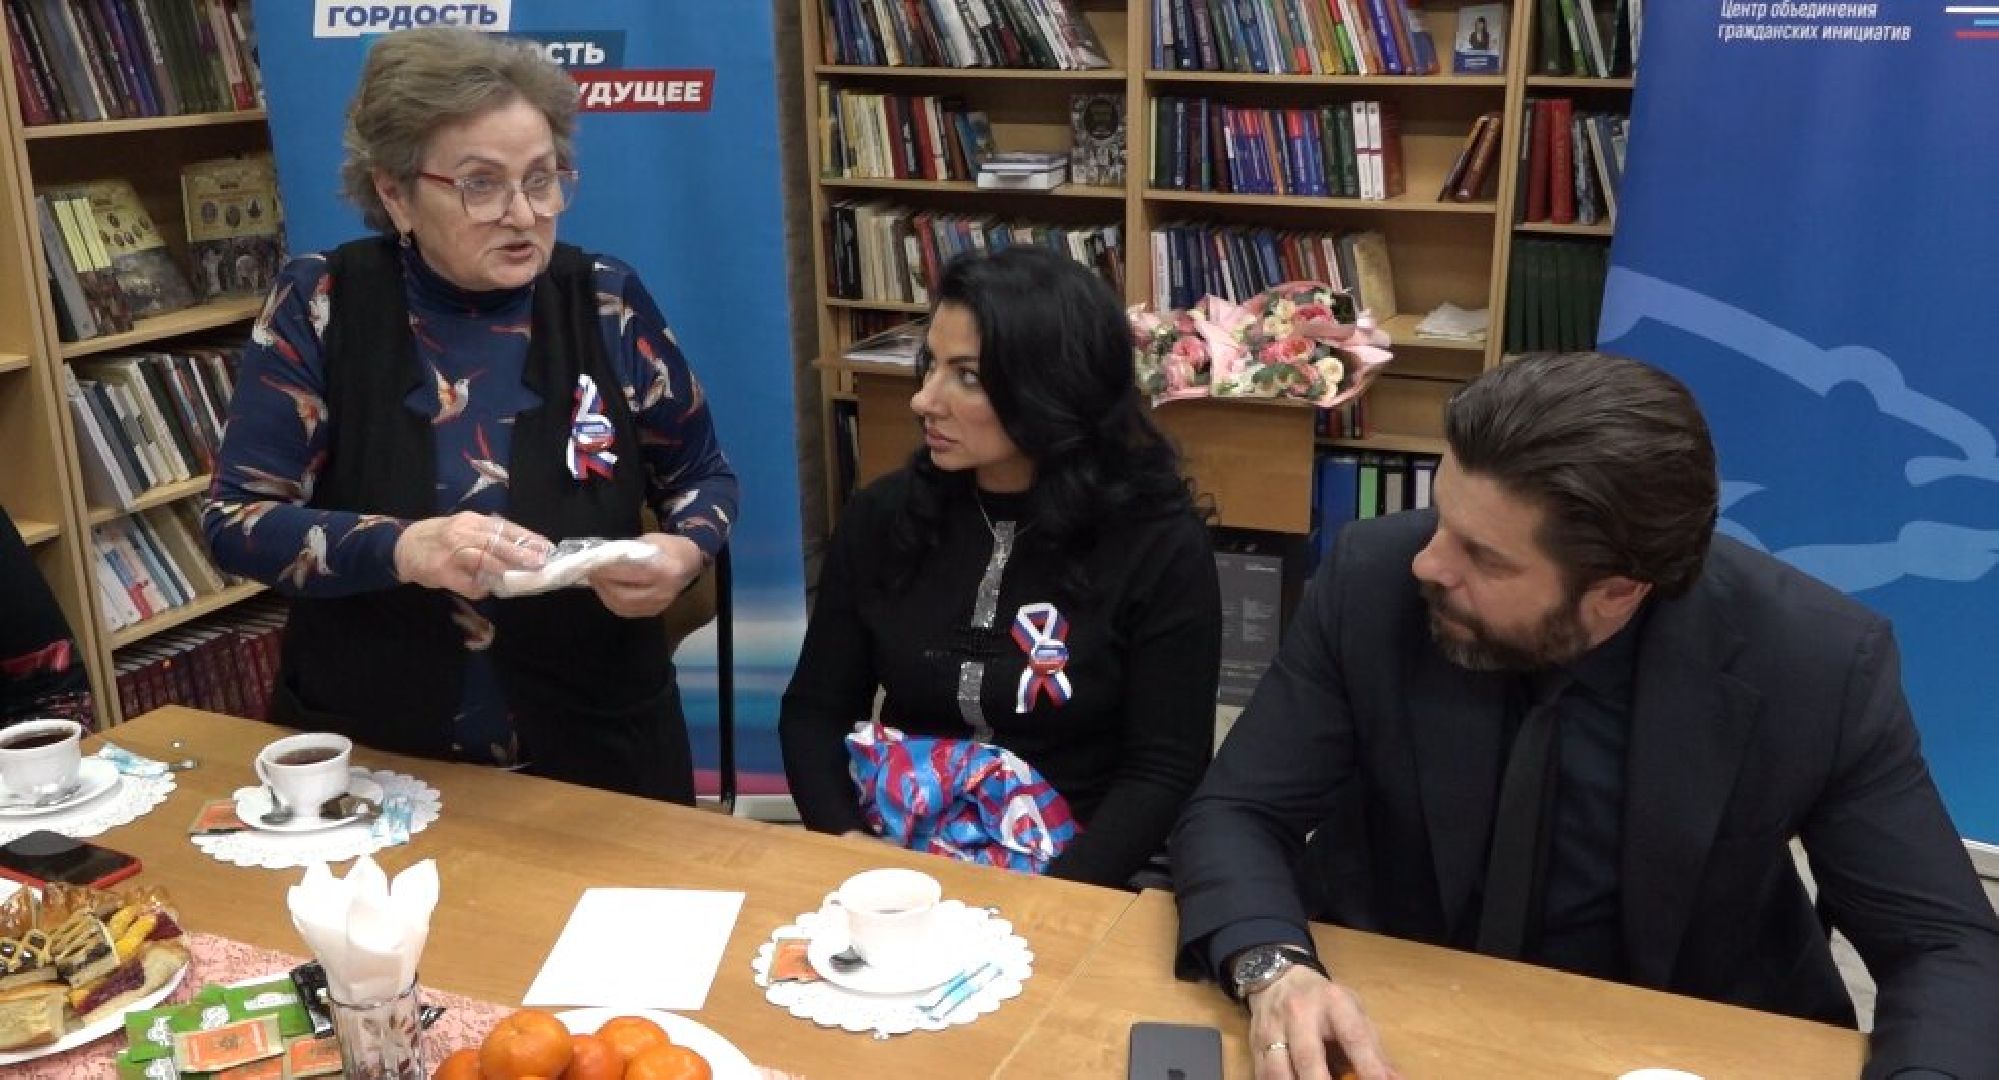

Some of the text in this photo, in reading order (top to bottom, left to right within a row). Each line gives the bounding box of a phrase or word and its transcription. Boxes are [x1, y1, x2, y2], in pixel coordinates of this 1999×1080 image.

[328, 5, 498, 30] ГОРДОСТЬ
[1720, 0, 1878, 20] Центр объединения
[1718, 23, 1912, 42] гражданских инициатив
